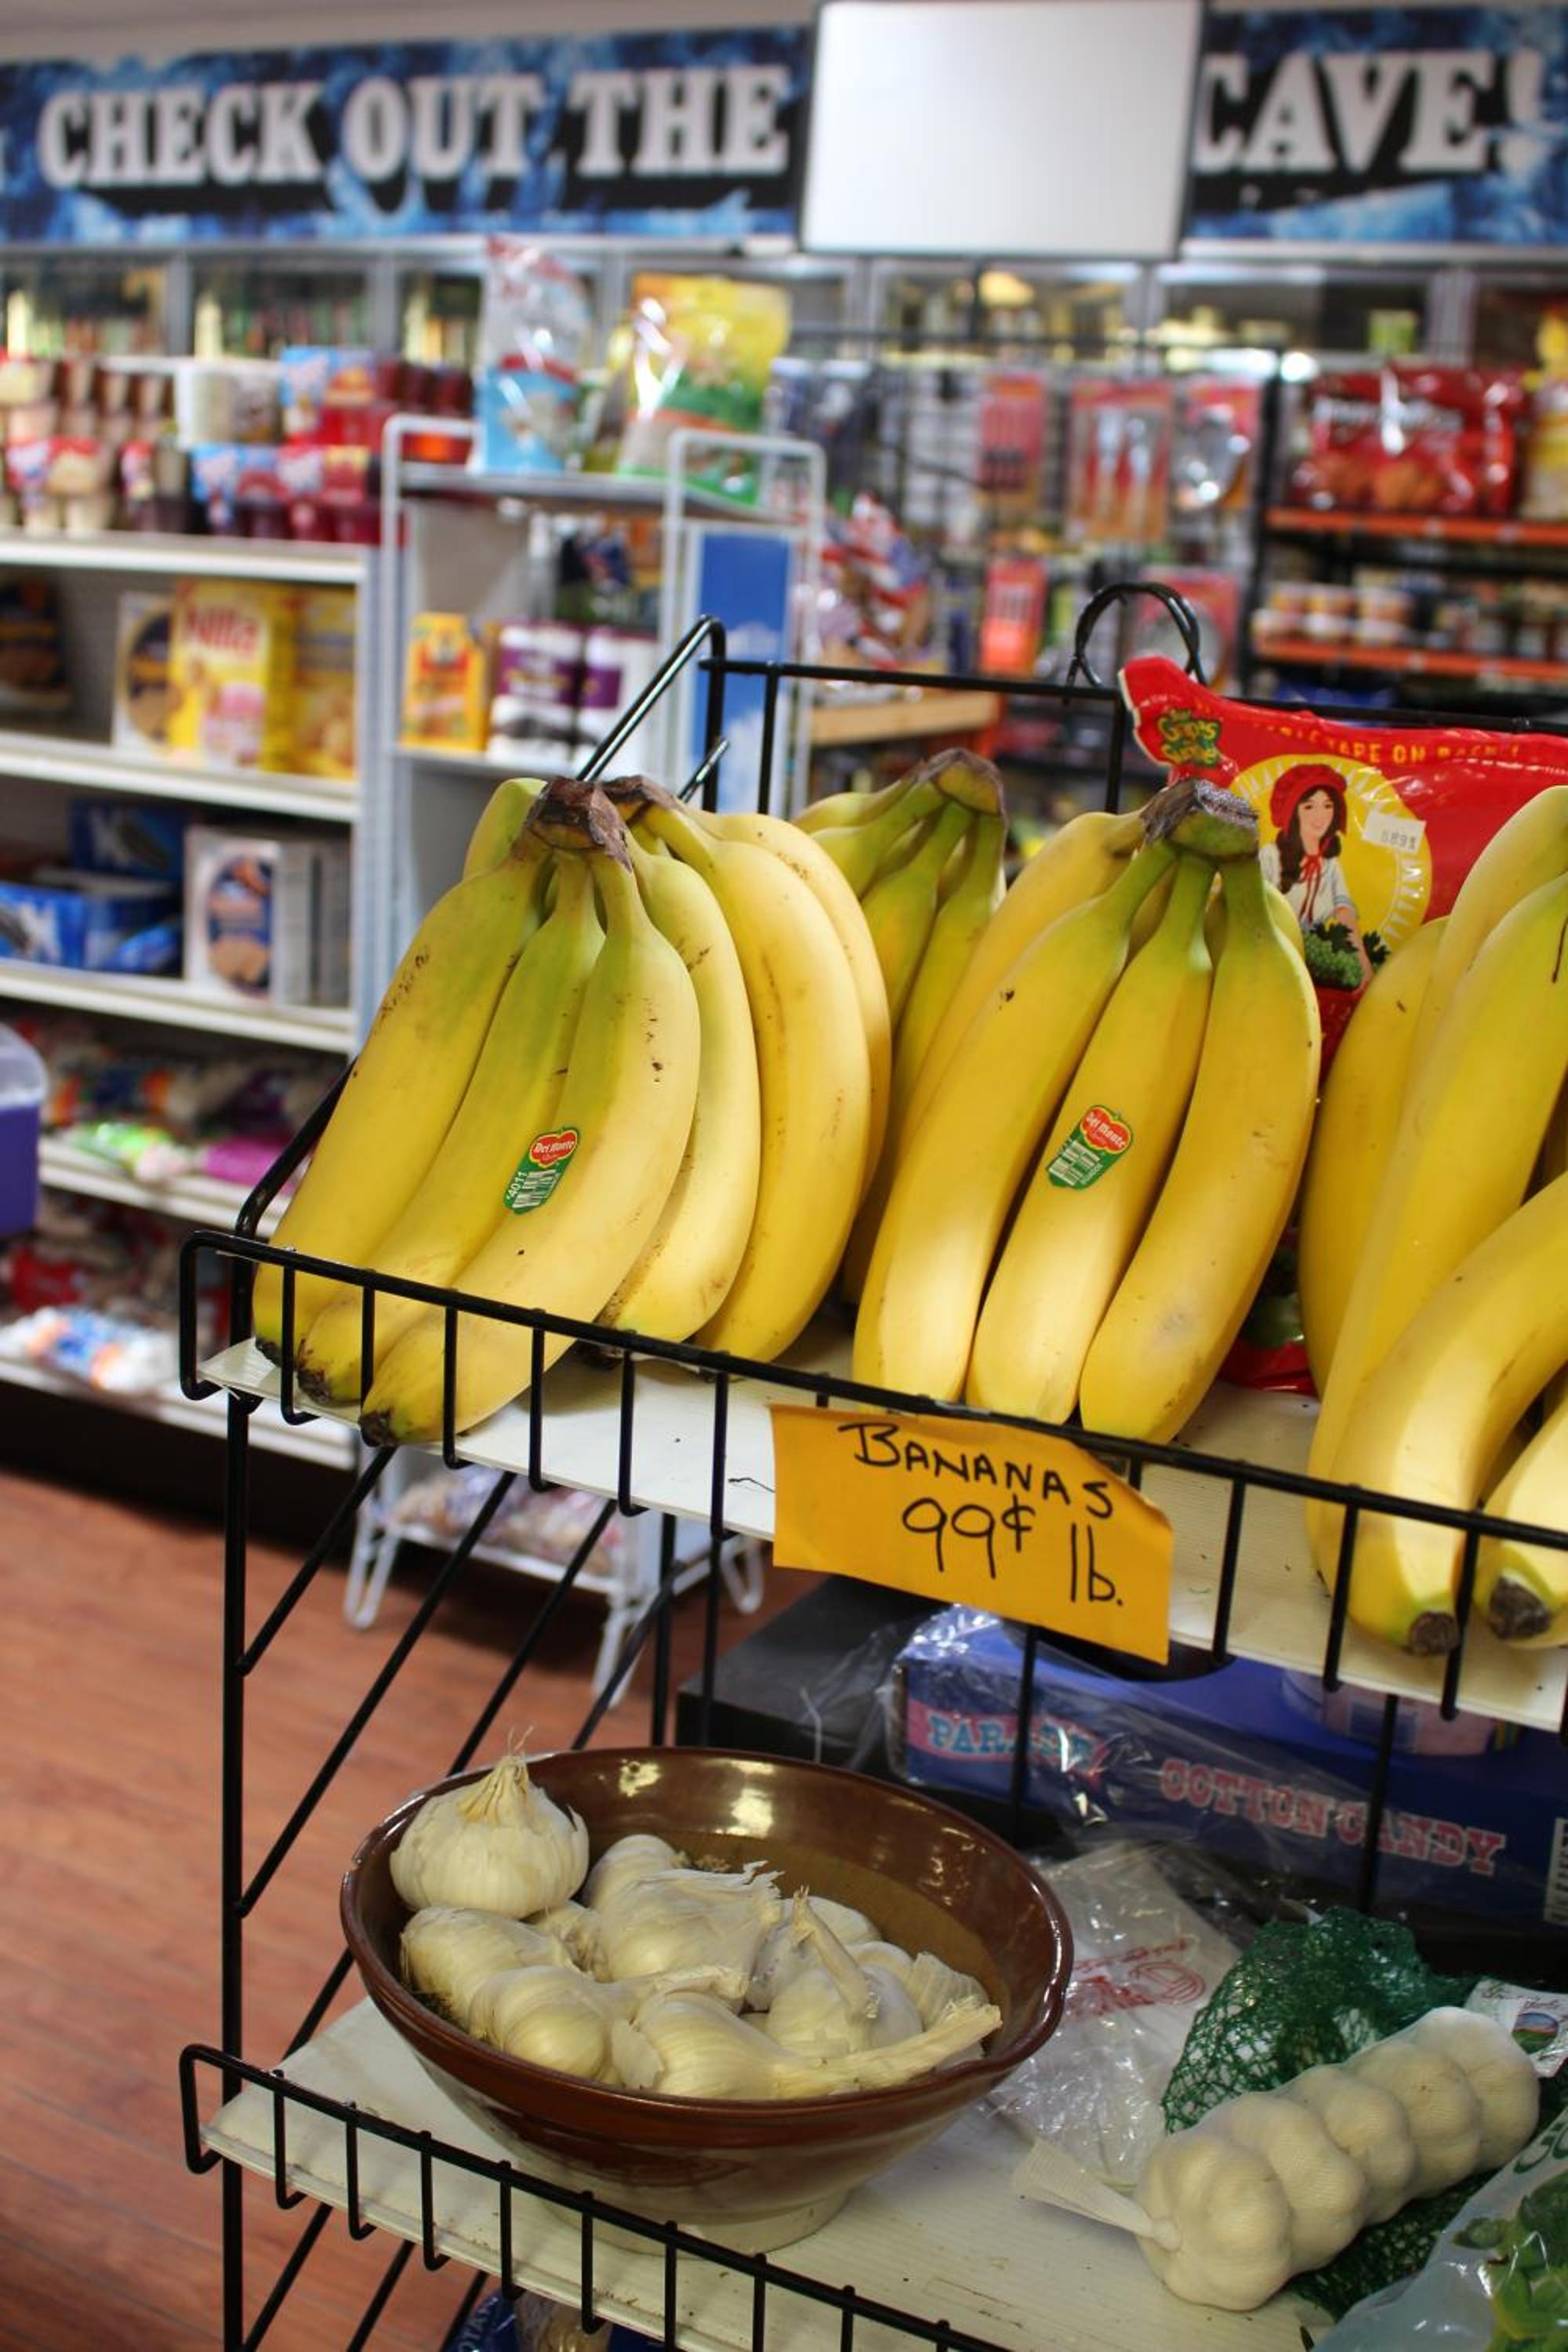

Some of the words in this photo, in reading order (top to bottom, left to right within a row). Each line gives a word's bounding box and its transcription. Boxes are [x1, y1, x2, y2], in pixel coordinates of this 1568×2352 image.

[38, 82, 324, 189] CHECK
[343, 73, 544, 181] OUT
[567, 64, 791, 177] THE
[1192, 50, 1549, 175] CAVE!
[1392, 744, 1426, 764] ON
[837, 1422, 1113, 1519] BANANAS
[902, 1493, 1036, 1580] 99¢
[1070, 1523, 1123, 1606] lb.
[1160, 1757, 1334, 1838] COTTON
